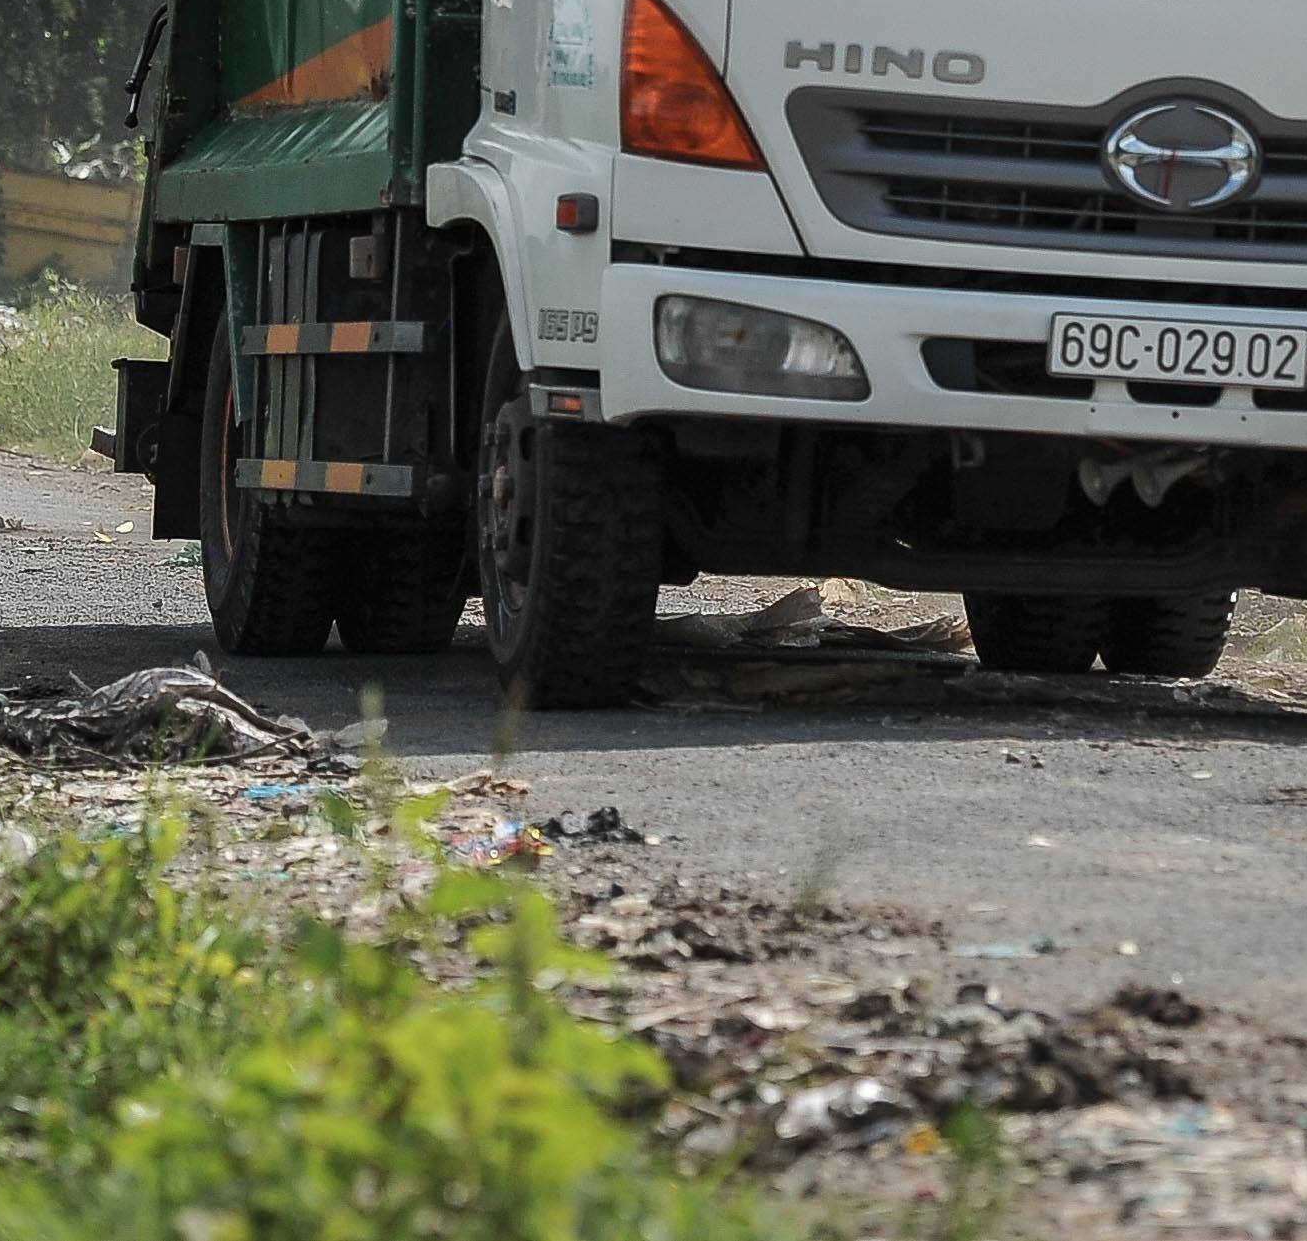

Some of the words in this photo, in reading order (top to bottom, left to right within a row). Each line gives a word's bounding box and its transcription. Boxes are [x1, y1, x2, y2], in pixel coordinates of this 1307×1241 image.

[783, 40, 985, 85] HINO
[570, 311, 599, 343] PS
[1060, 321, 1299, 381] 69C-029.02
